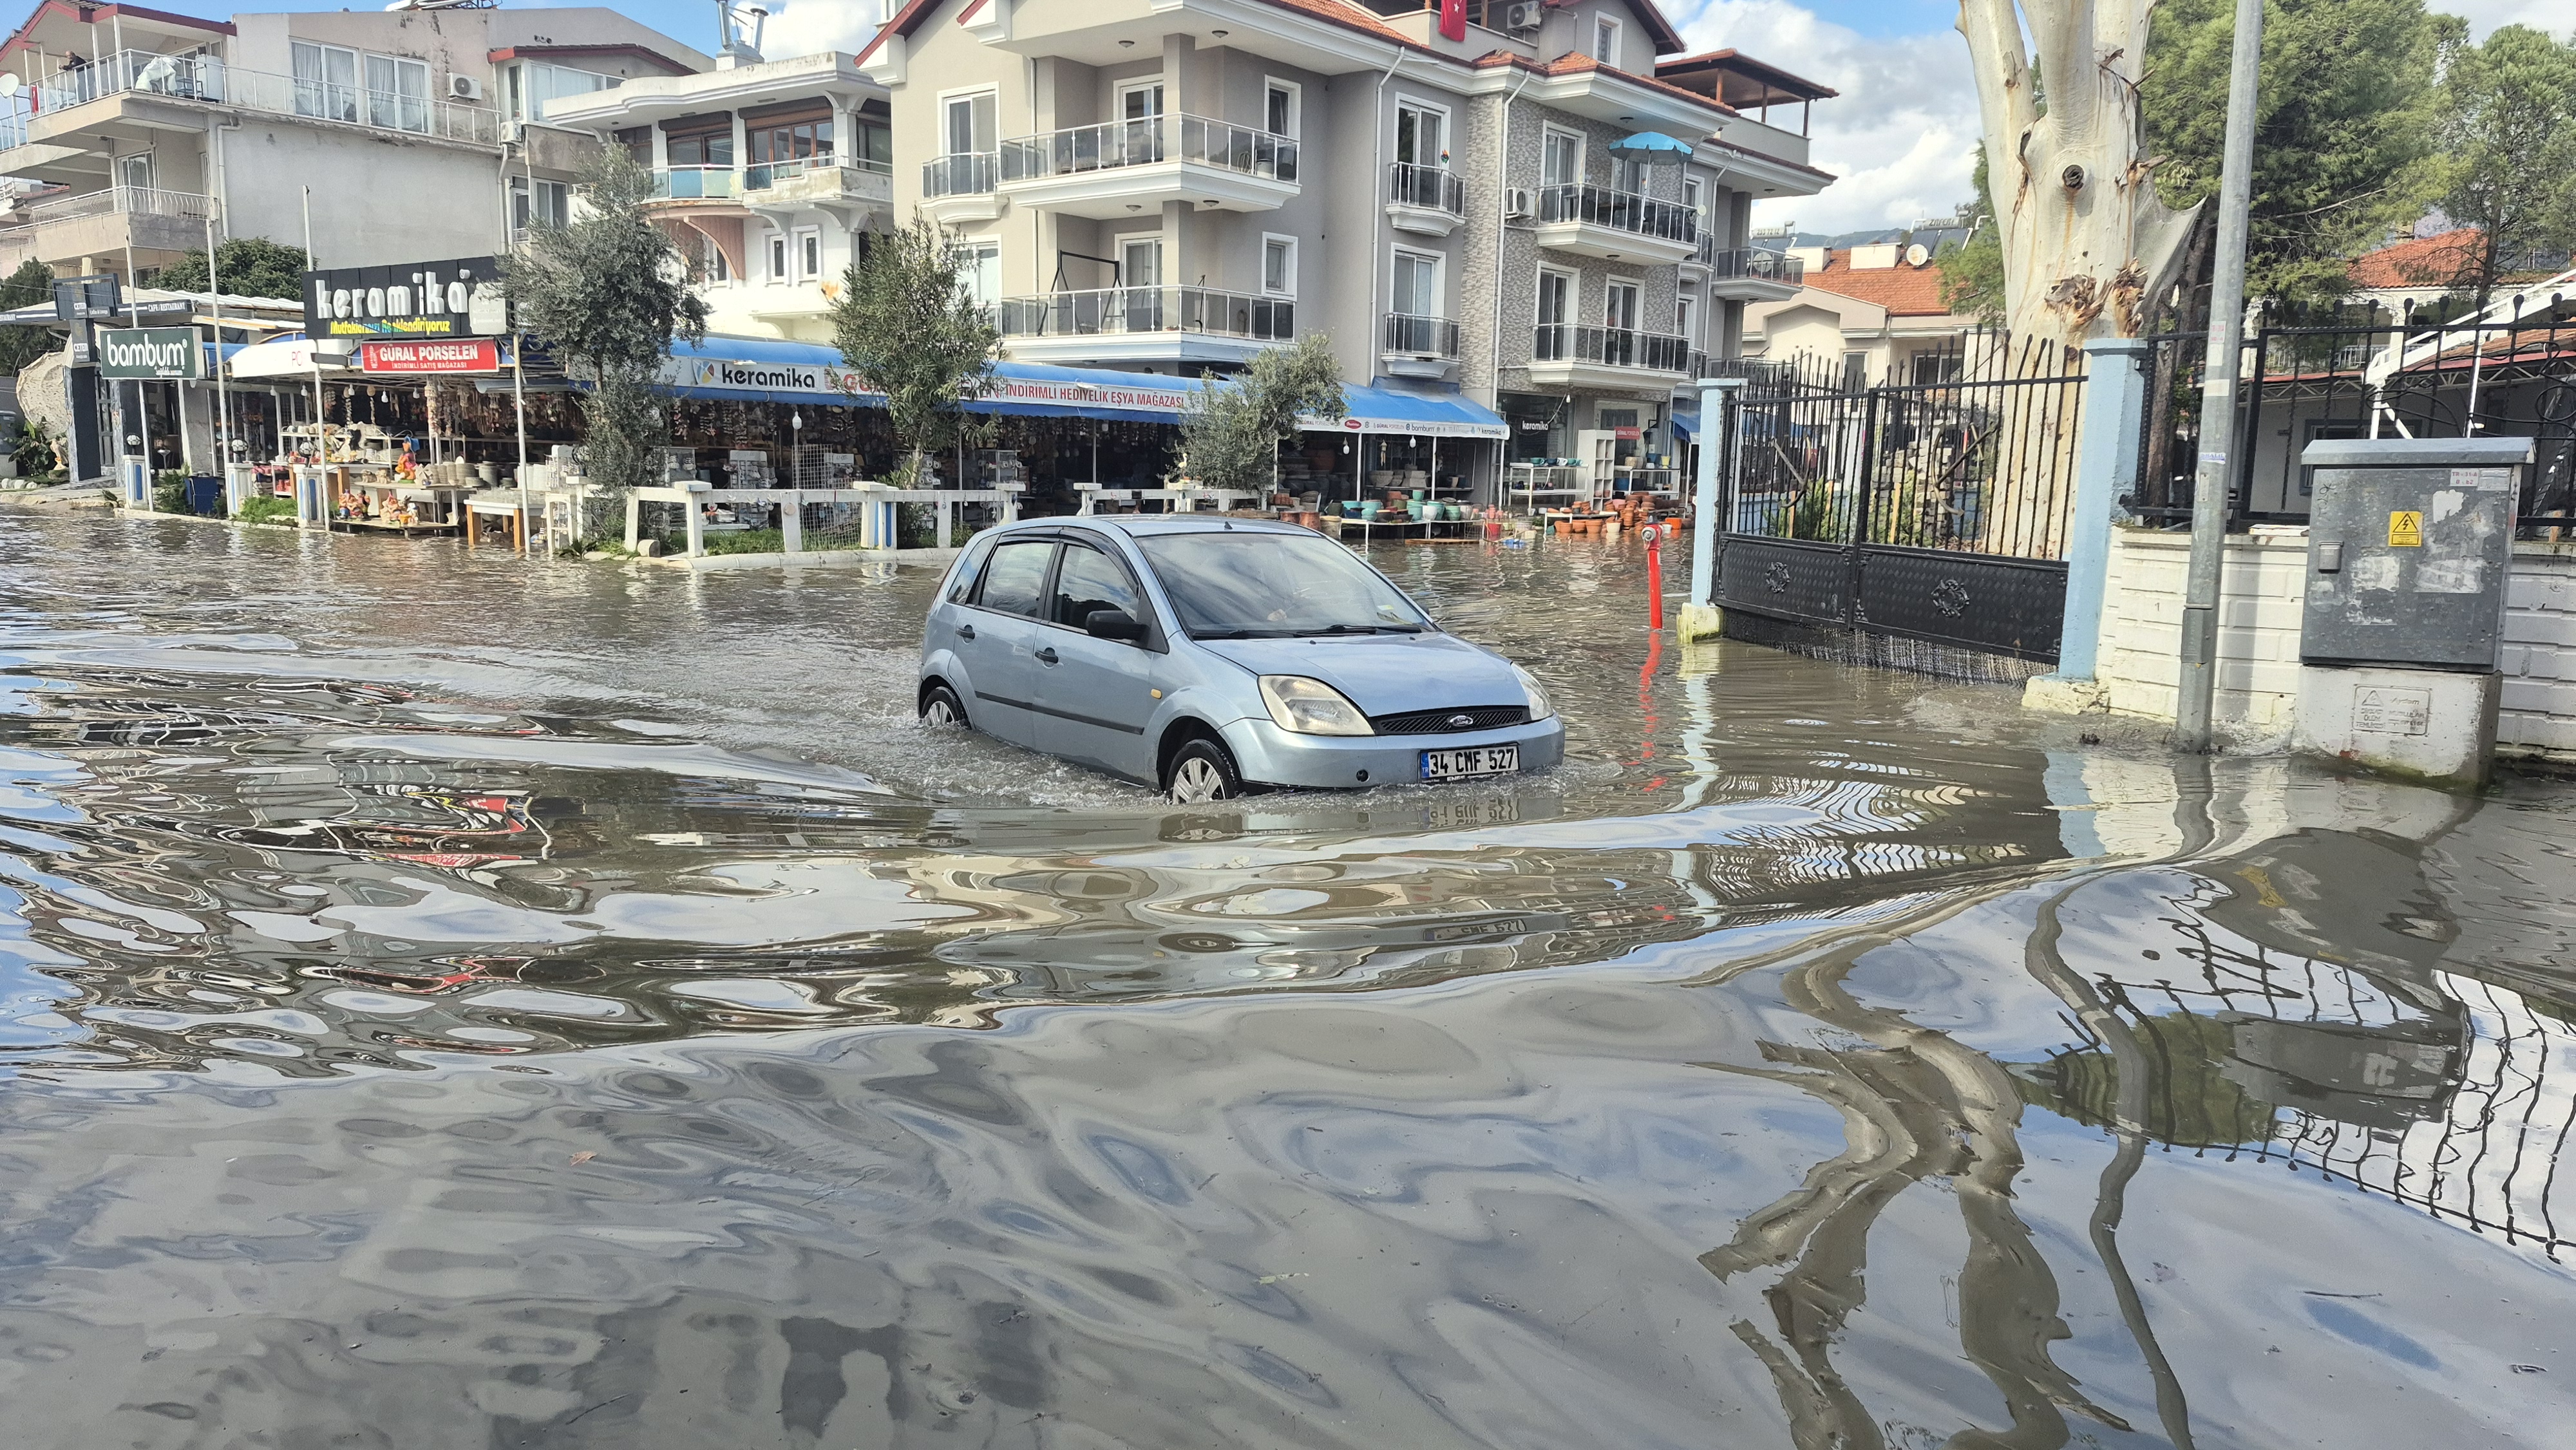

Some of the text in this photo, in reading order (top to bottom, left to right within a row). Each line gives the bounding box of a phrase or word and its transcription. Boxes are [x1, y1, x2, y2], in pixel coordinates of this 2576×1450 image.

[316, 271, 468, 319] keramika
[107, 333, 185, 366] bambum
[379, 343, 478, 361] GÜRAL PORSELEN
[419, 362, 437, 370] SATIŞ
[721, 363, 815, 388] keramika
[1111, 391, 1134, 407] EŞYA
[1137, 391, 1184, 408] MAĞAZASI
[1522, 420, 1549, 431] keramika
[1430, 753, 1448, 775] 34
[1455, 751, 1481, 773] CMF
[1488, 749, 1514, 770] 527
